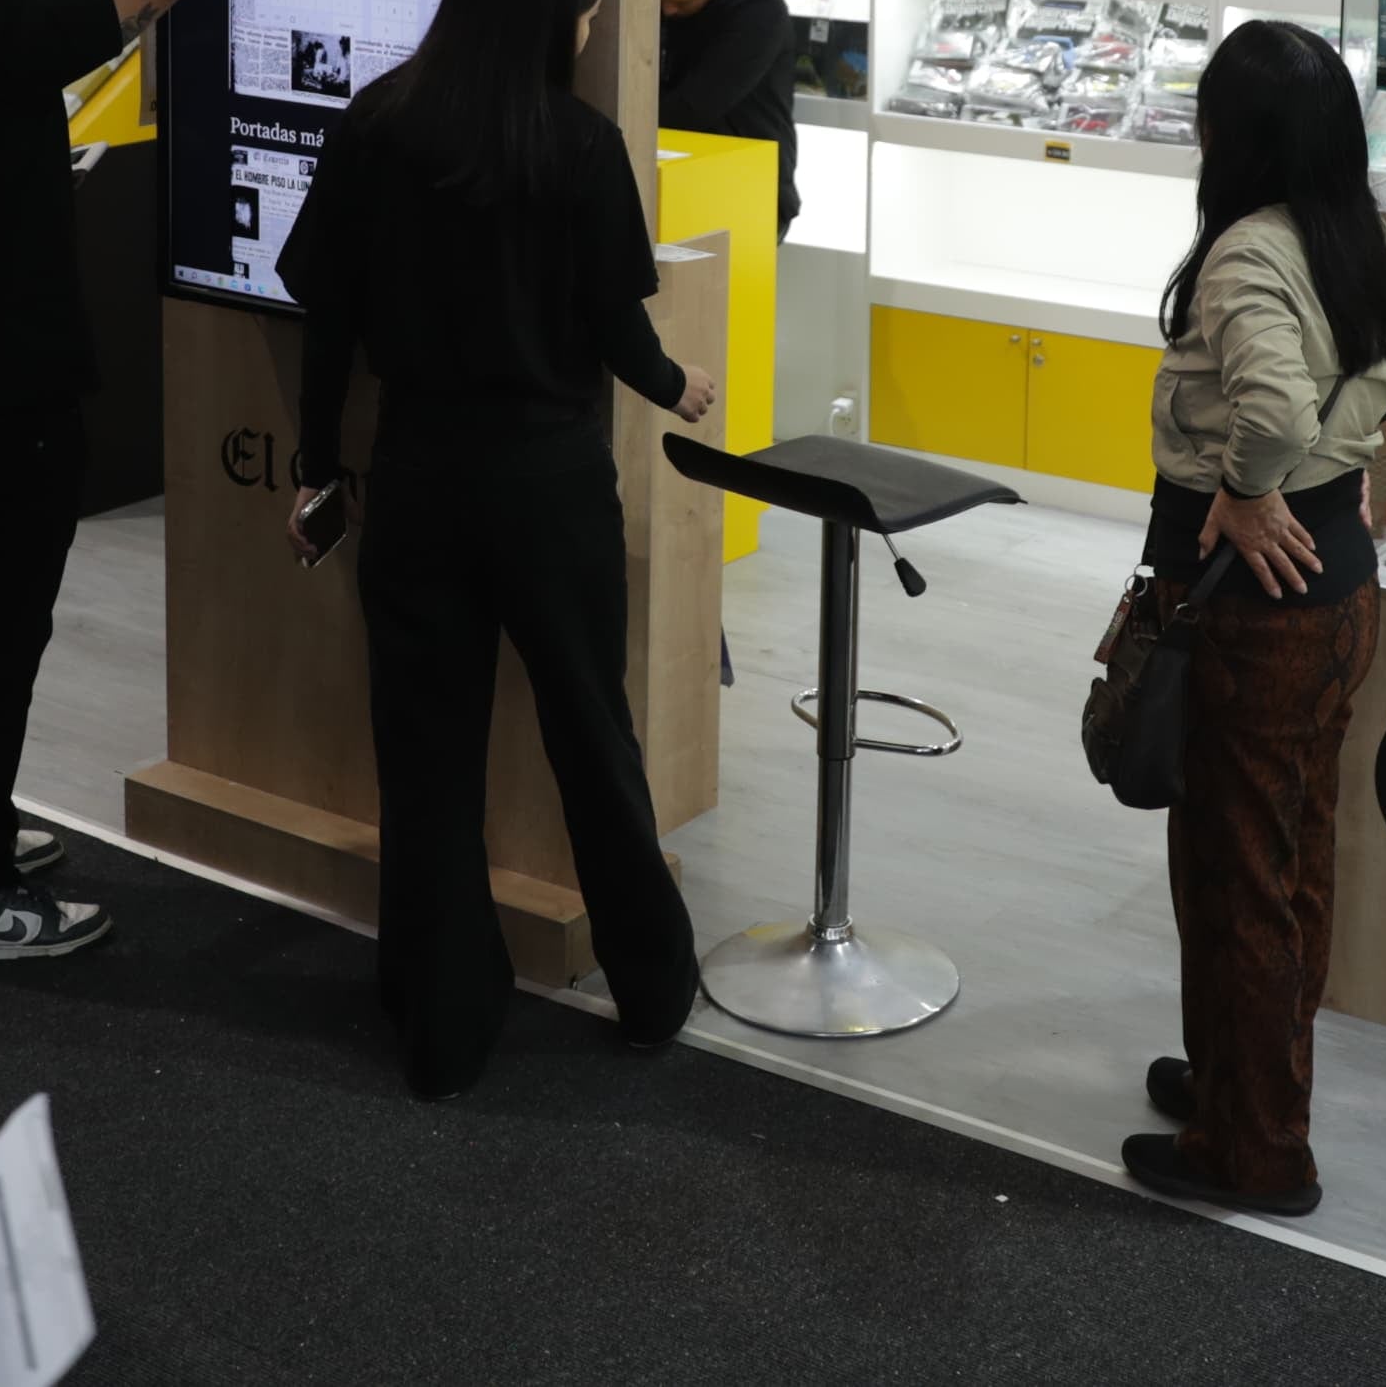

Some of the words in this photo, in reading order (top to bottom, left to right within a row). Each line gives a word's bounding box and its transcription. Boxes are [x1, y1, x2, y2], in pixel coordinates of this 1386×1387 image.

[229, 117, 296, 143] Portadas
[244, 171, 269, 186] HOMBRE
[287, 178, 295, 190] LA
[221, 425, 279, 493] El
